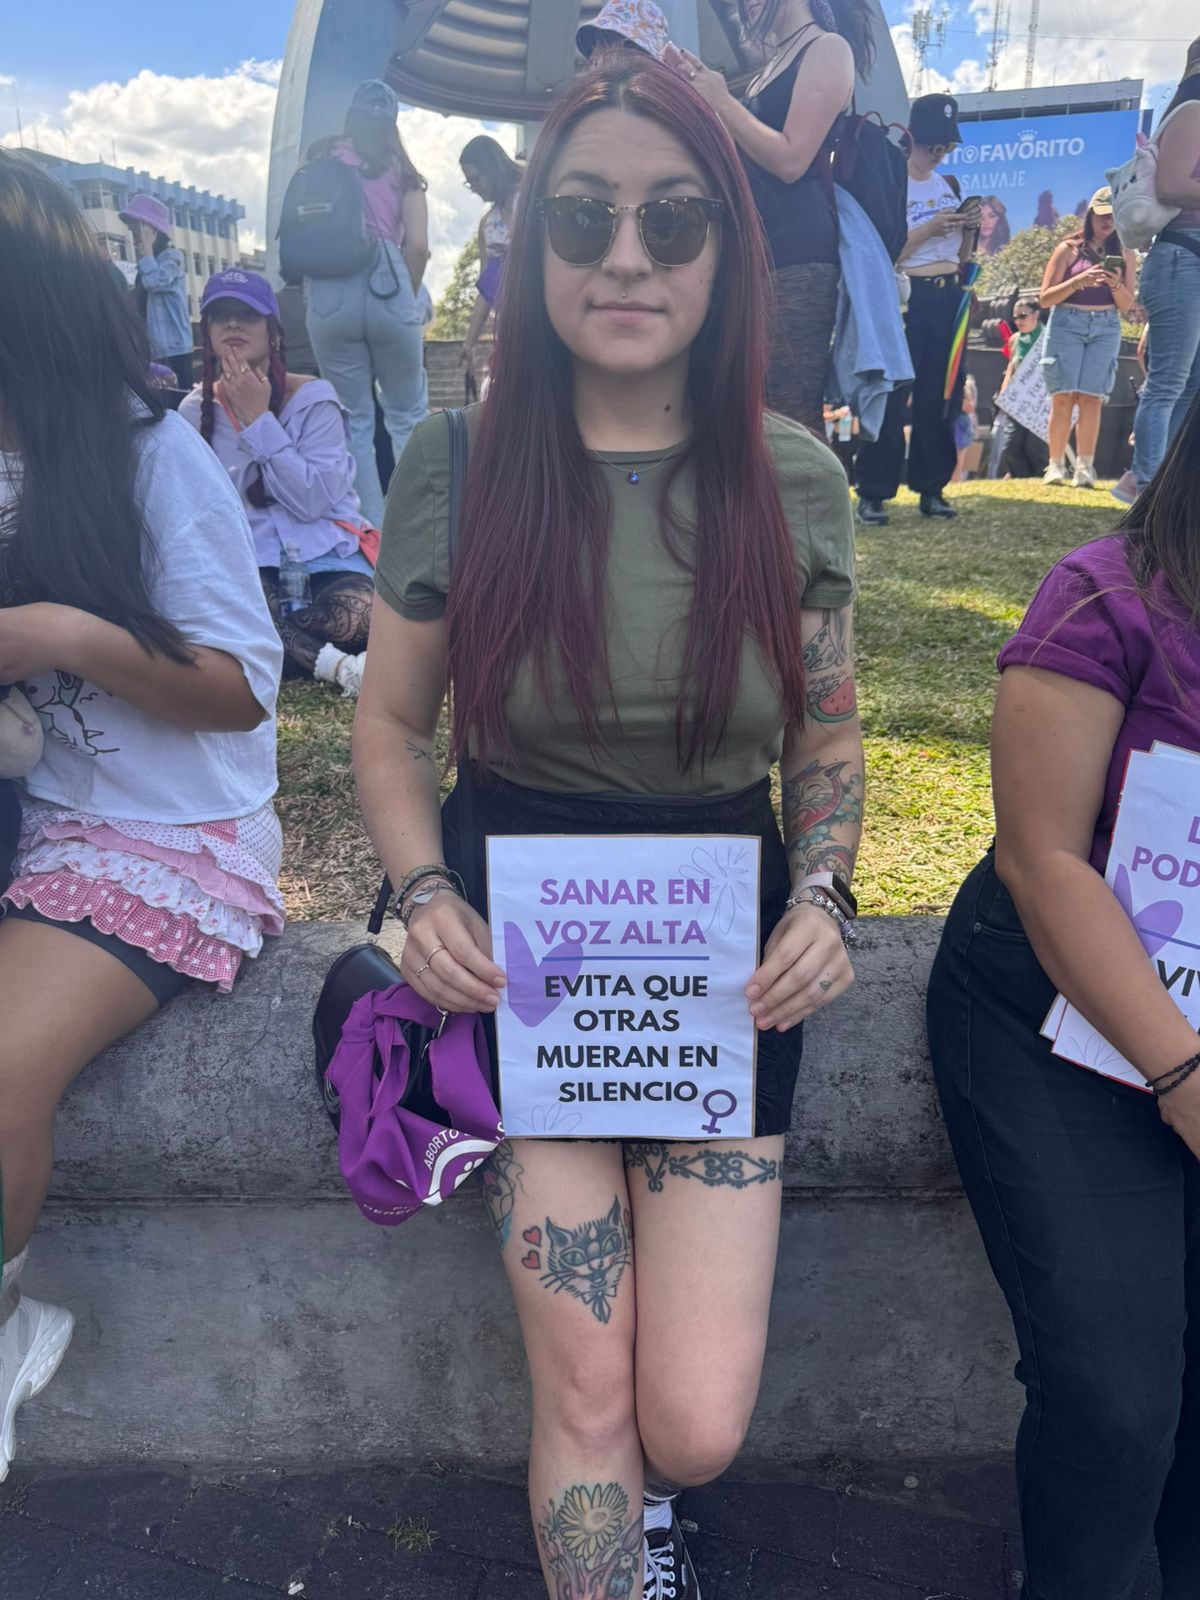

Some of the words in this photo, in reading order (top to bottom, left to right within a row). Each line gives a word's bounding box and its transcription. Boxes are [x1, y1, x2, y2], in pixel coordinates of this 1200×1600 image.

[961, 170, 1026, 190] SALVAJE
[539, 878, 658, 906] SANAR
[667, 878, 711, 905] EN
[535, 920, 612, 945] VOZ
[620, 920, 708, 945] ALTA
[544, 974, 636, 998] EVITA
[643, 975, 708, 1002] QUE
[1156, 959, 1200, 997] VI
[573, 1009, 681, 1032] OTRAS
[536, 1045, 669, 1069] MUERAN
[679, 1045, 718, 1068] EN
[558, 1080, 699, 1103] SILENCIO
[423, 1129, 460, 1171] ABORTO
